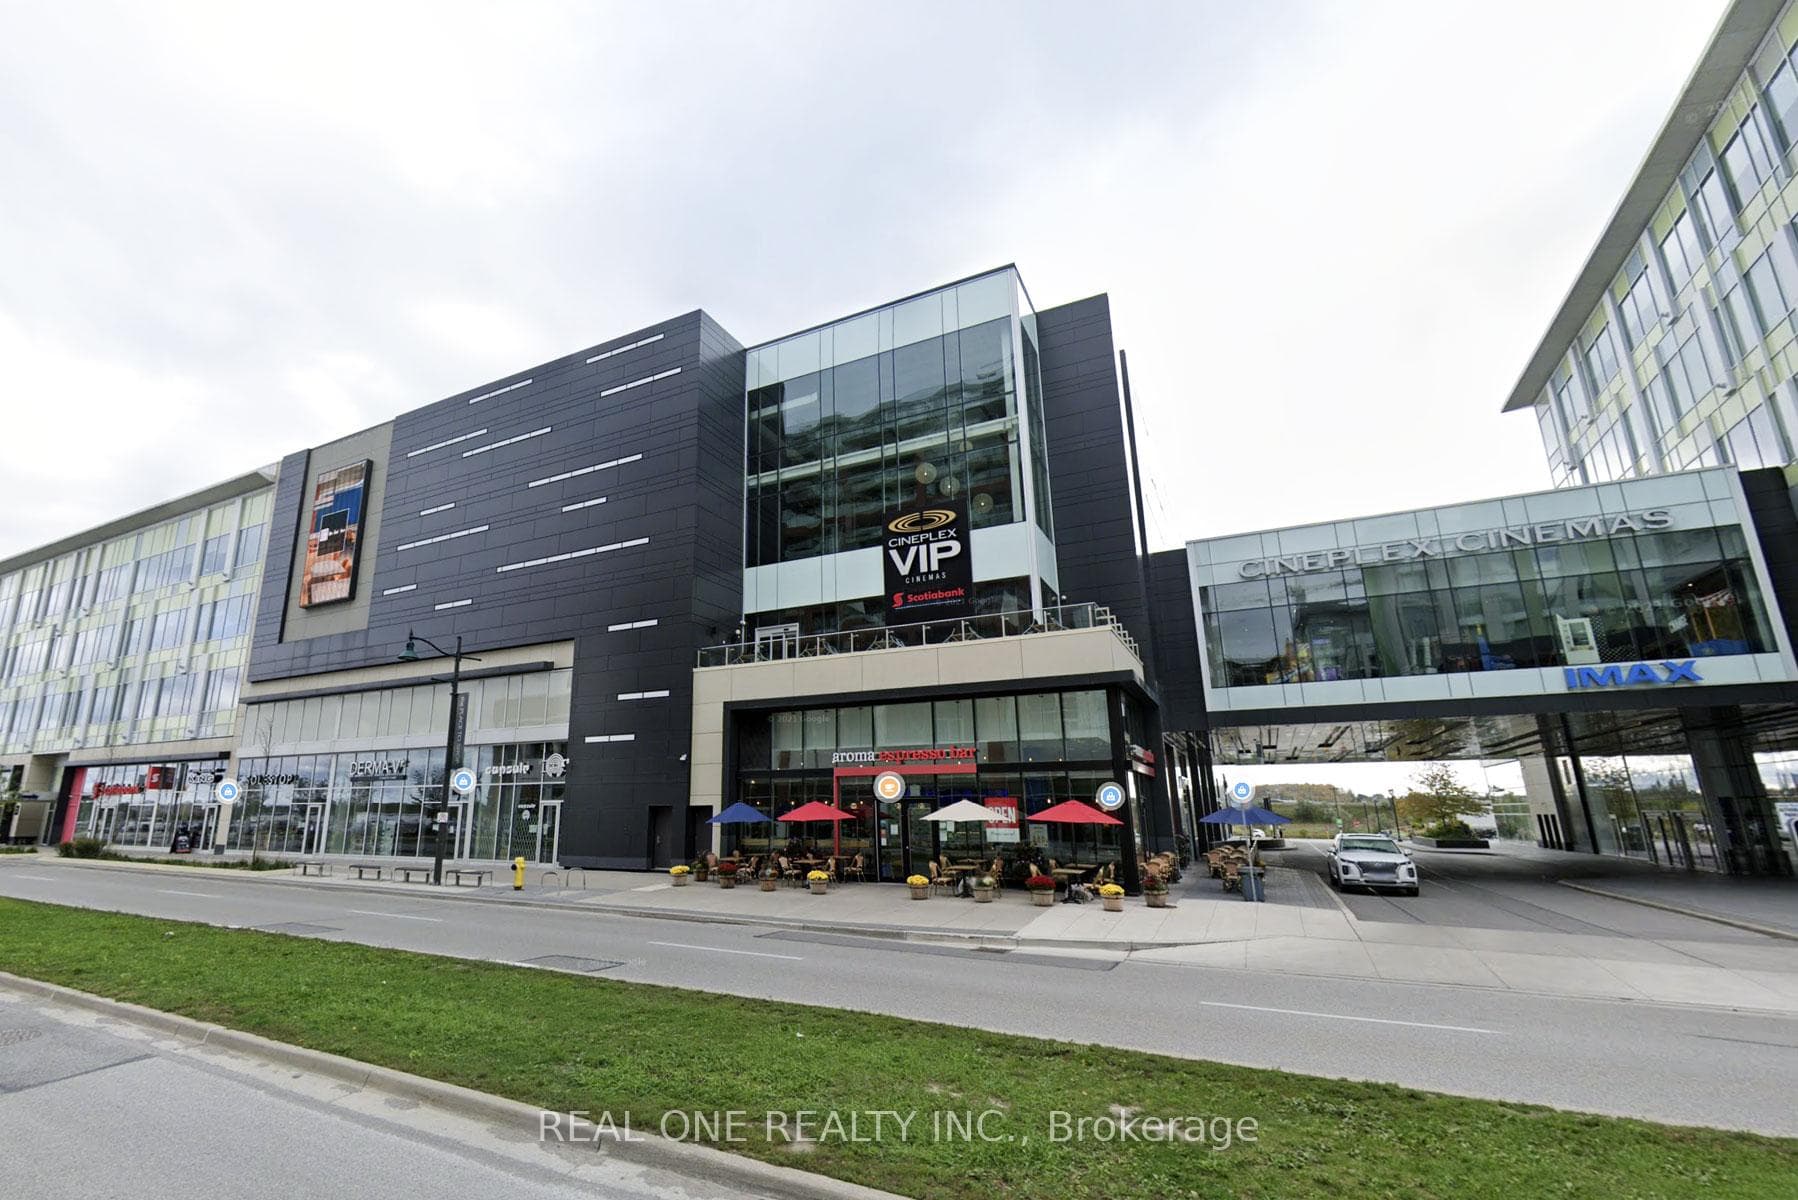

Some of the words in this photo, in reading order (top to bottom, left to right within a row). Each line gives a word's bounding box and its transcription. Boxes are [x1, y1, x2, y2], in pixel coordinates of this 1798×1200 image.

[888, 528, 957, 548] CINEPLEX
[1238, 539, 1437, 579] CINEPLEX
[1455, 508, 1677, 552] CINEMAS
[888, 540, 961, 577] VIP
[905, 571, 947, 585] CINEMAS
[906, 587, 965, 604] Scotiabank
[1564, 659, 1704, 690] IMAX
[832, 751, 875, 763] aroma
[879, 749, 946, 765] espresso
[950, 744, 977, 760] bar
[484, 761, 531, 776] capsule
